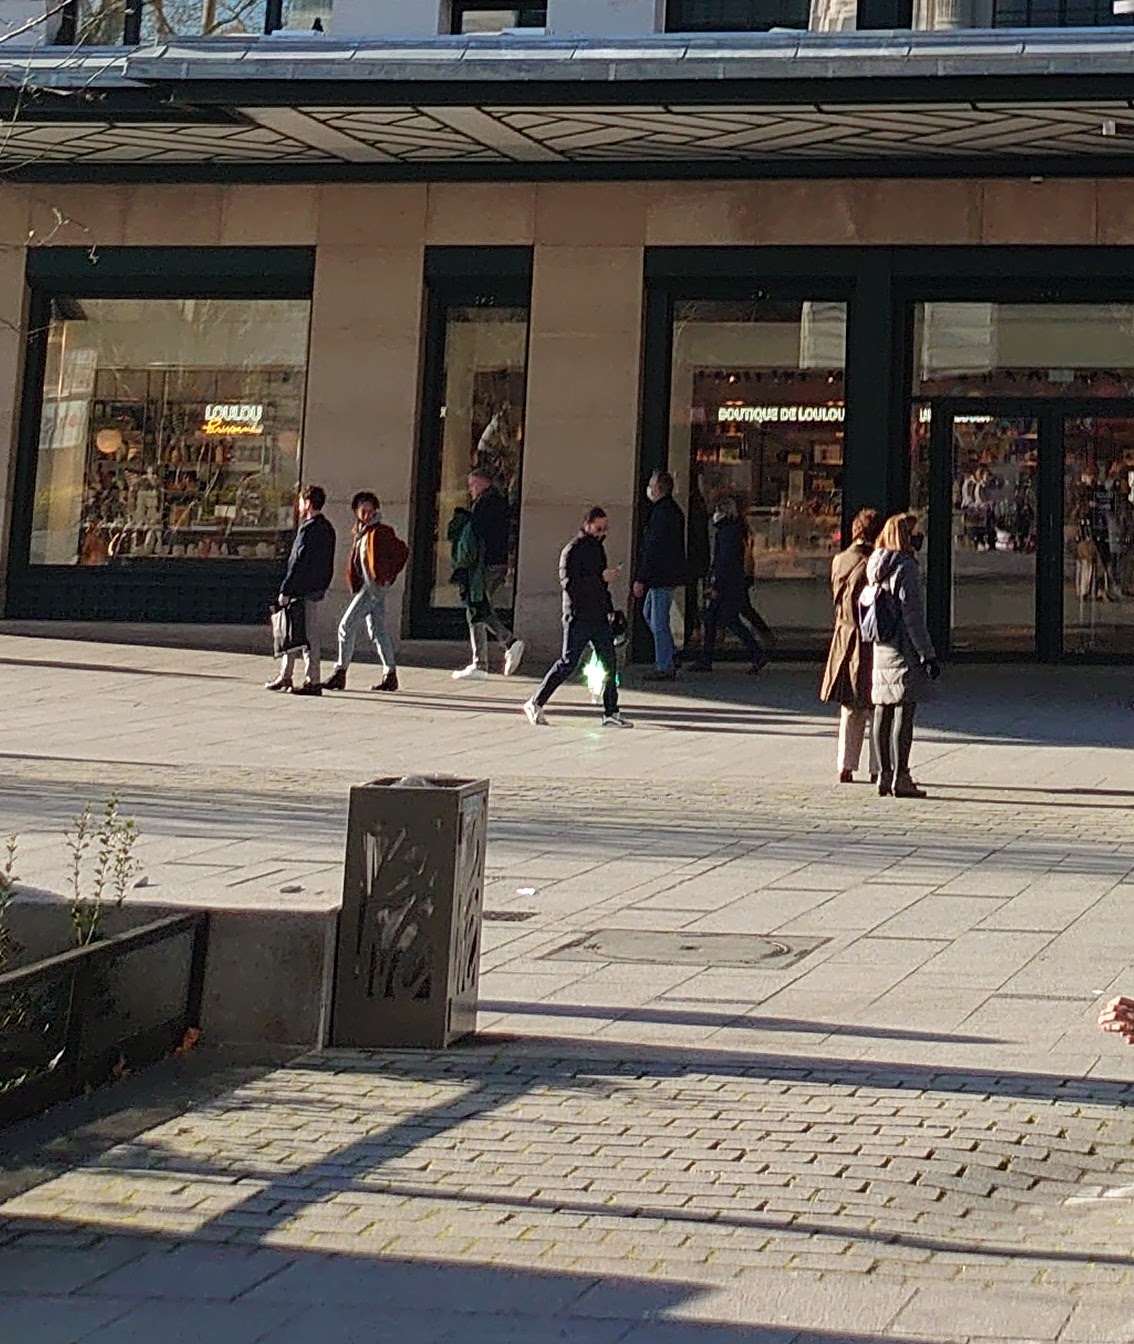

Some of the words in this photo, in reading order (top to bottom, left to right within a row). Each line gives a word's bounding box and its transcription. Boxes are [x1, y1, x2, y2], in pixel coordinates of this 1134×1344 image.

[205, 404, 263, 421] LOULOU
[718, 407, 778, 422] BOUTIQUE
[780, 406, 796, 421] DE
[798, 406, 845, 421] LOULOU
